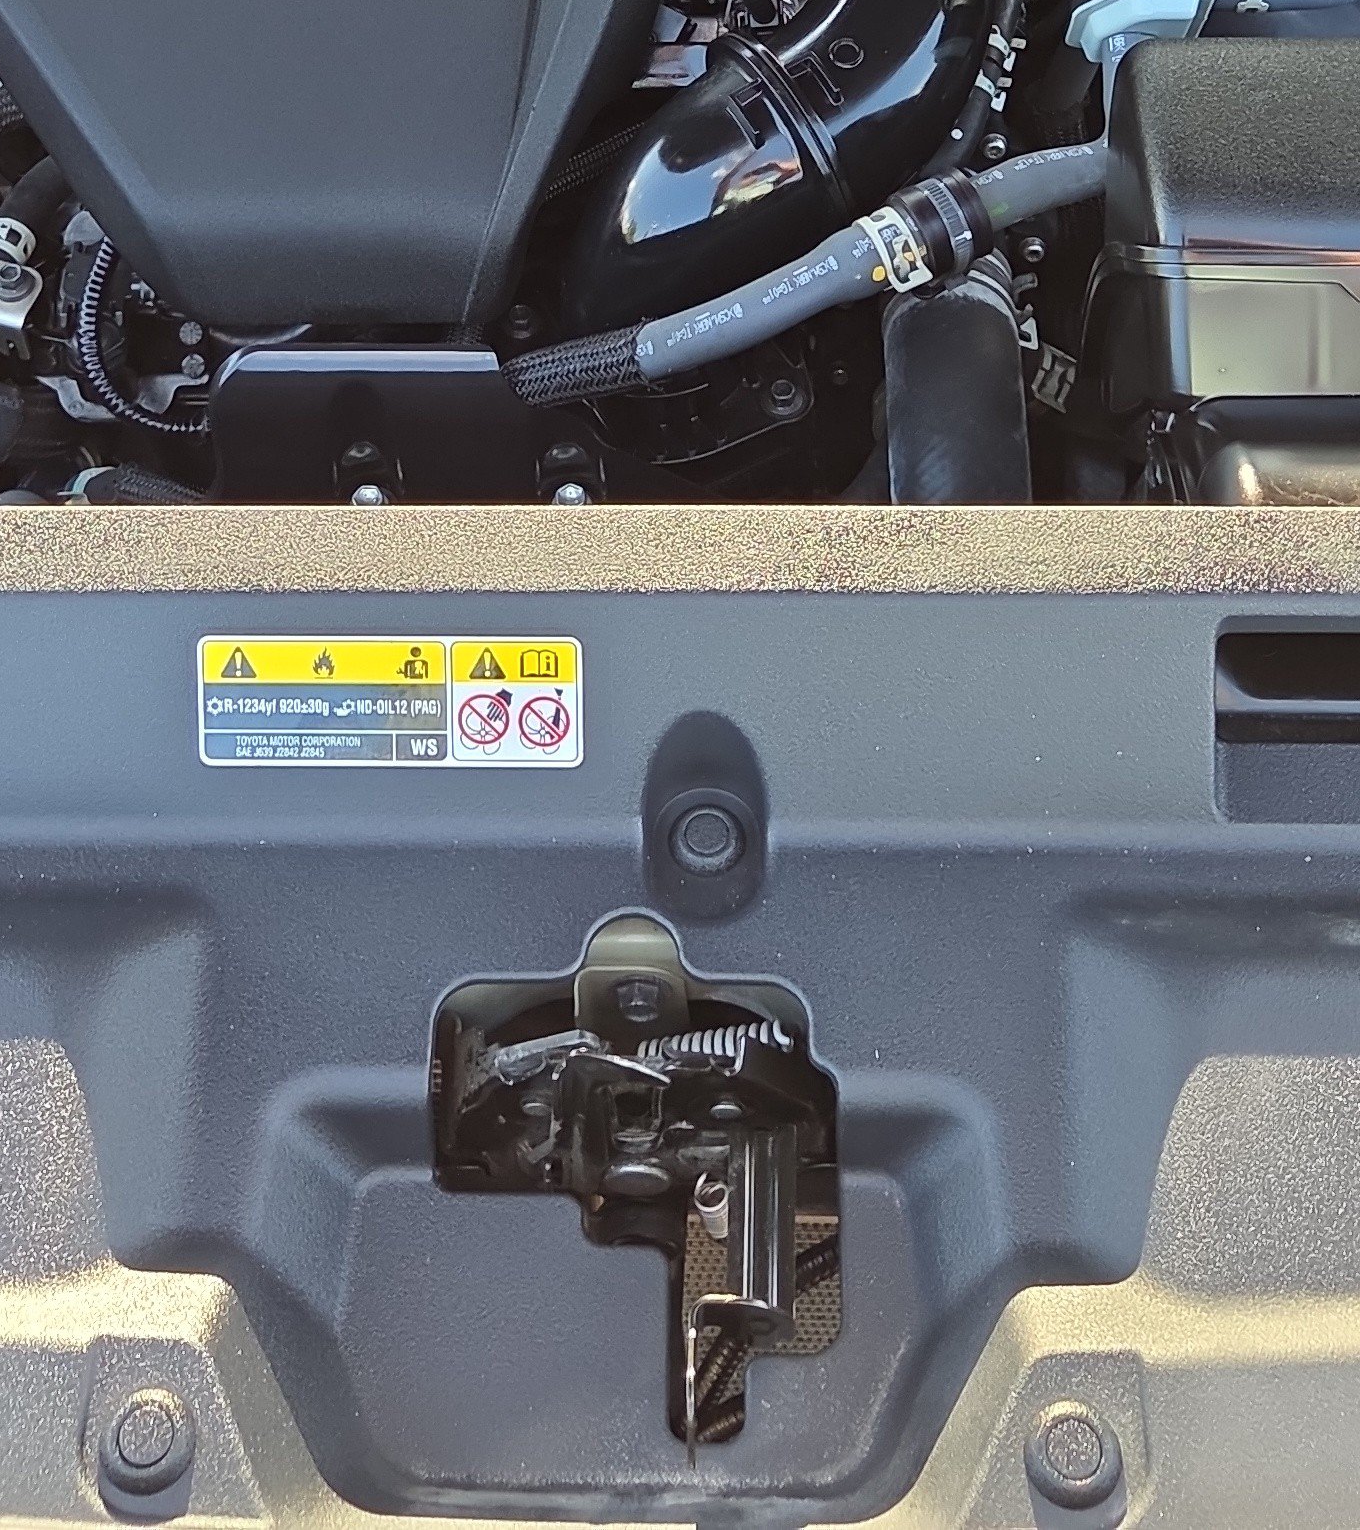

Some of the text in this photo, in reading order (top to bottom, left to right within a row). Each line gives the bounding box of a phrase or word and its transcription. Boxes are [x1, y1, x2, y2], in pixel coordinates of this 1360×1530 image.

[224, 698, 330, 717] R-1234yf 920±30g
[356, 699, 442, 718] ND-OIL12 (PAG)
[236, 735, 361, 747] TOYOTA MOTOR CORPORATION
[410, 738, 438, 756] WS
[235, 746, 253, 758] SAE
